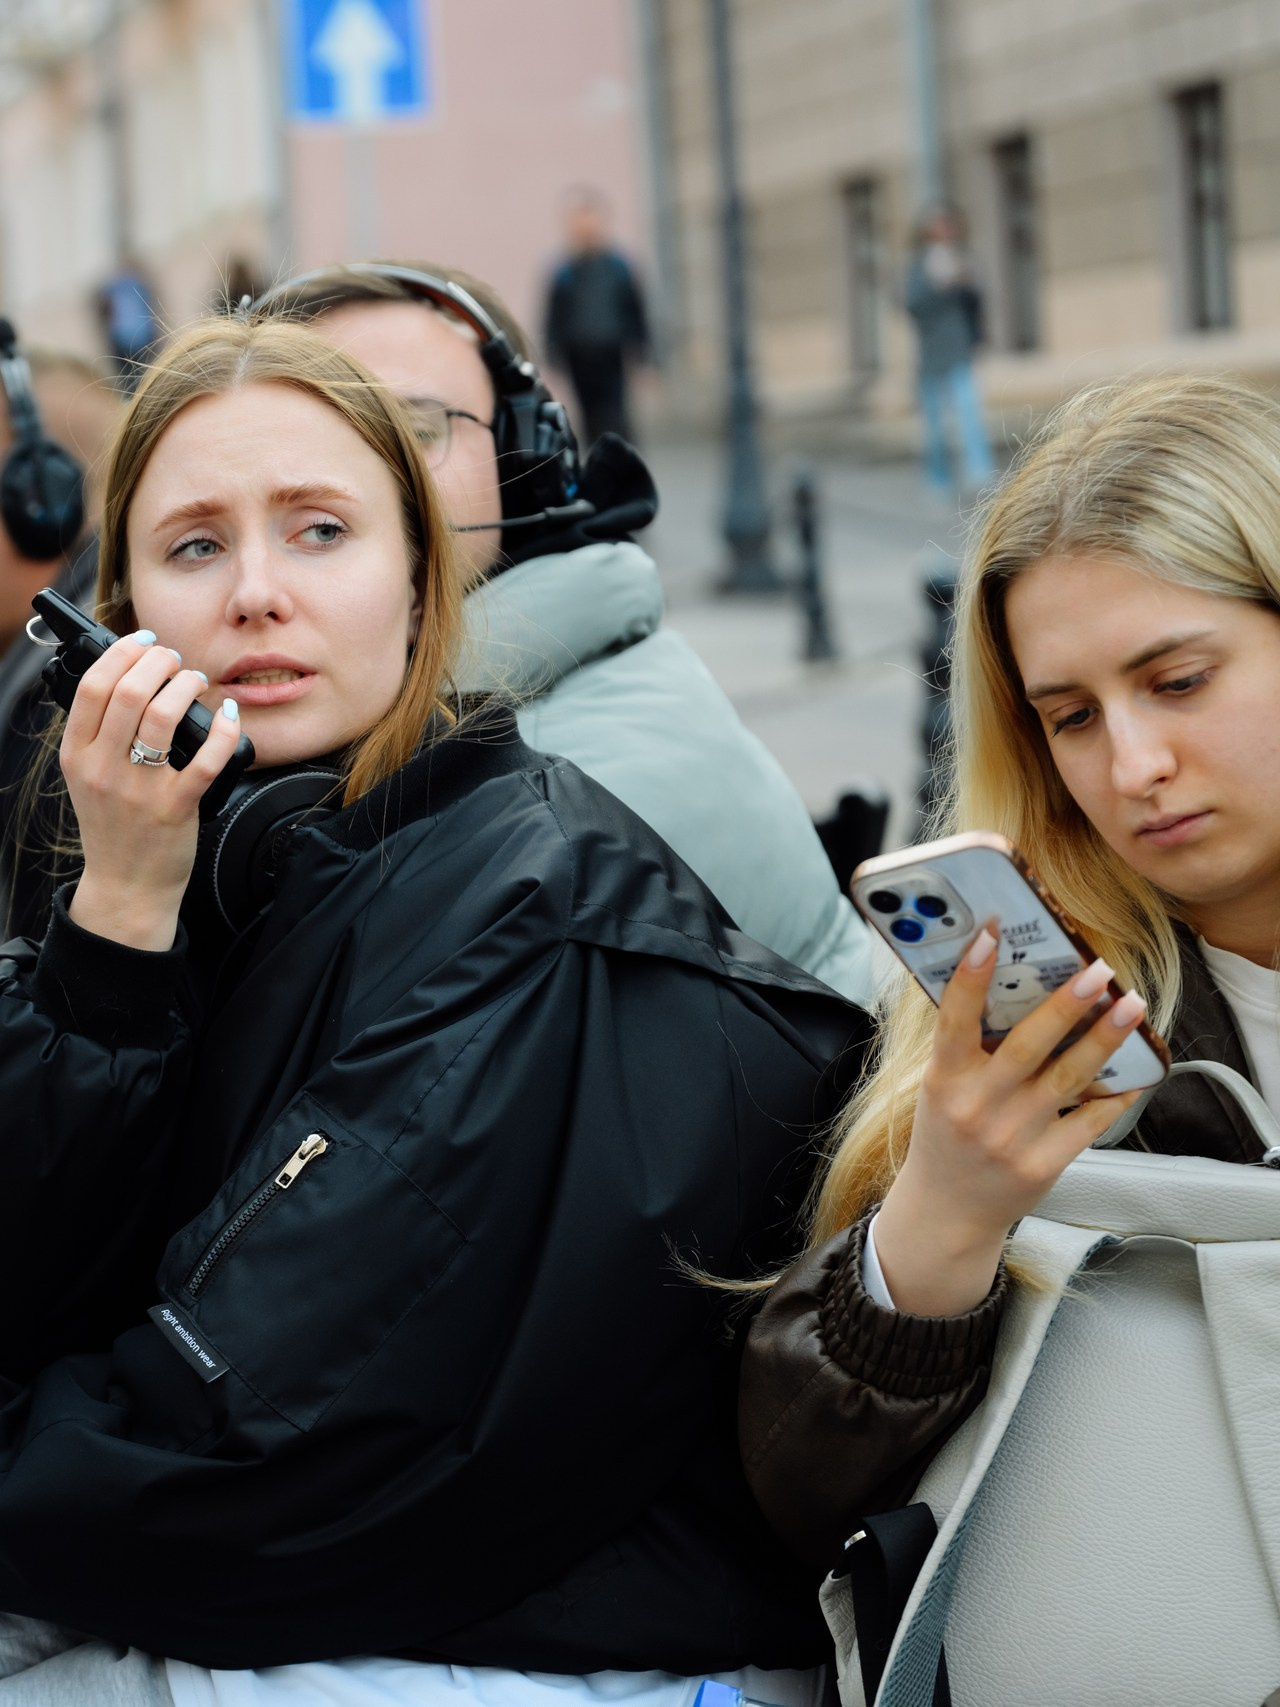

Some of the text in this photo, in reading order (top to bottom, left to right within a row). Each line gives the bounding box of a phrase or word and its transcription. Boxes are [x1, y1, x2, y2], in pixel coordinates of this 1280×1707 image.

[161, 1308, 217, 1369] Right ambition wear
